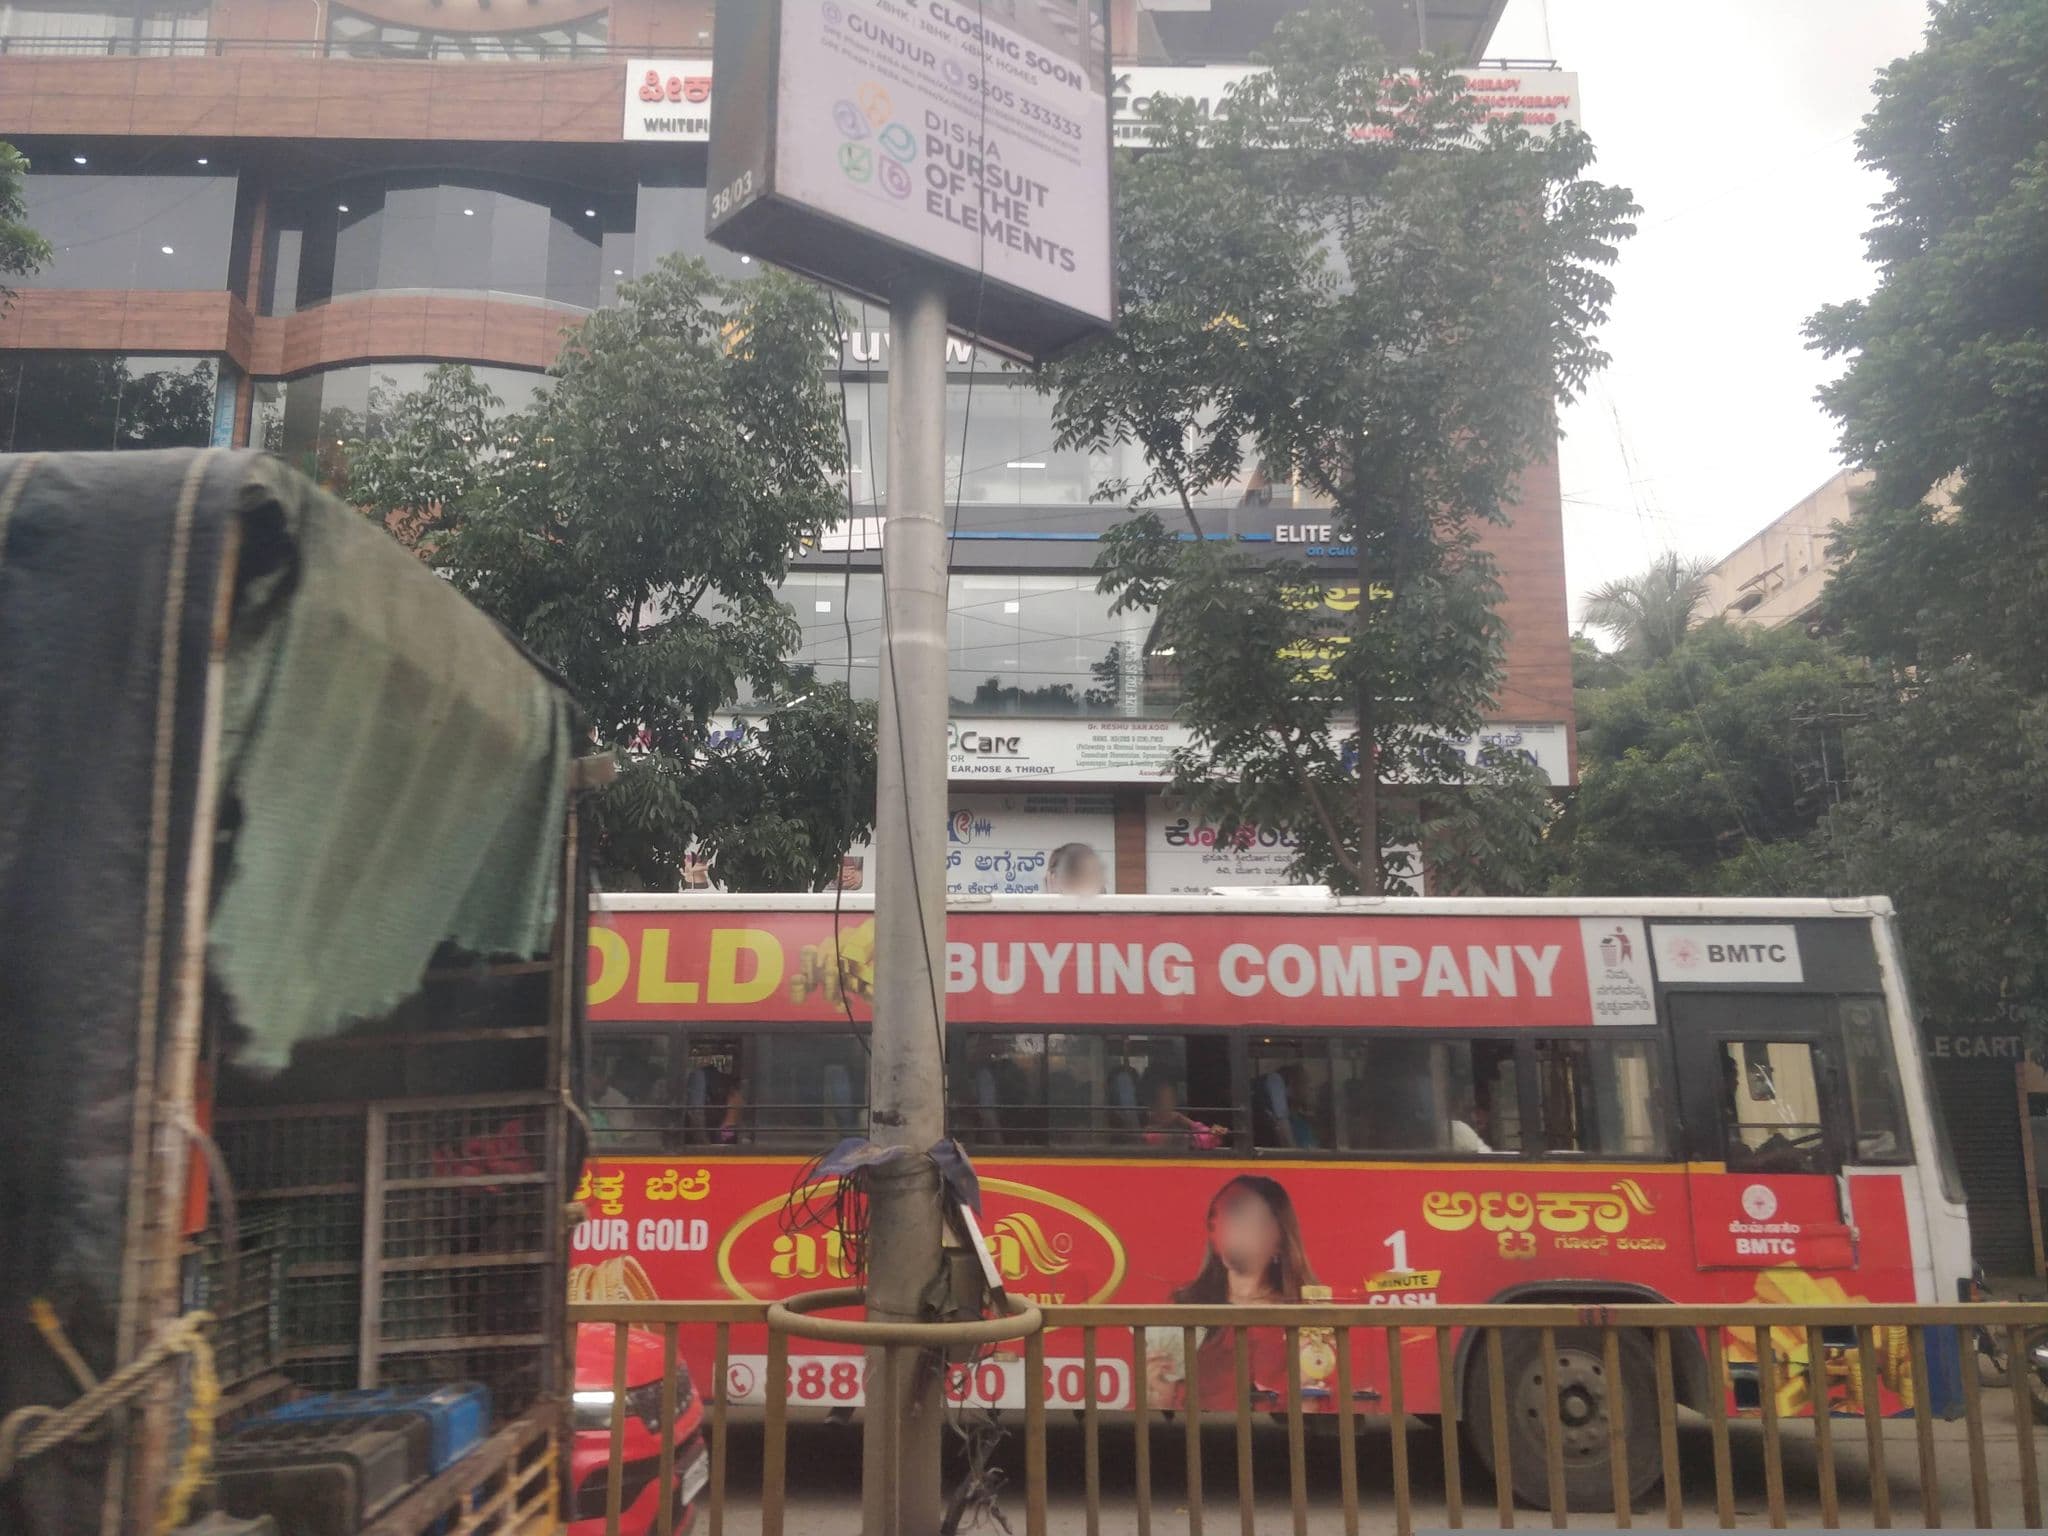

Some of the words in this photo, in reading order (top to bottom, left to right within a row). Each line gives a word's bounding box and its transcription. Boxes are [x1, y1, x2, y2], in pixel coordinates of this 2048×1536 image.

[847, 14, 937, 69] GUNJUR
[930, 1, 1021, 60] CLOSING
[1024, 49, 1083, 92] SOON
[996, 57, 1039, 87] HOMES
[643, 118, 708, 133] WHITEFI
[925, 109, 1000, 160] DISHA
[925, 134, 1049, 208] PURSUIT
[711, 169, 753, 219] 38/03
[925, 163, 966, 196] OF
[972, 182, 1030, 227] THE
[926, 189, 1076, 272] ELEMENTS
[1276, 525, 1332, 542] ELITE
[951, 765, 1002, 775] EAR,NOSE
[1005, 765, 1012, 774] &
[1015, 765, 1055, 775] THROAT
[587, 928, 785, 1005] OLD
[945, 941, 1196, 997] BUYING
[1218, 942, 1562, 998] COMPANY
[1706, 943, 1787, 963] BMTC
[646, 1168, 711, 1200] ಬೆಲೆ
[573, 1218, 629, 1251] OUR
[637, 1218, 709, 1251] GOLD
[1383, 1229, 1416, 1273] 1
[1735, 1238, 1796, 1255] BMTC
